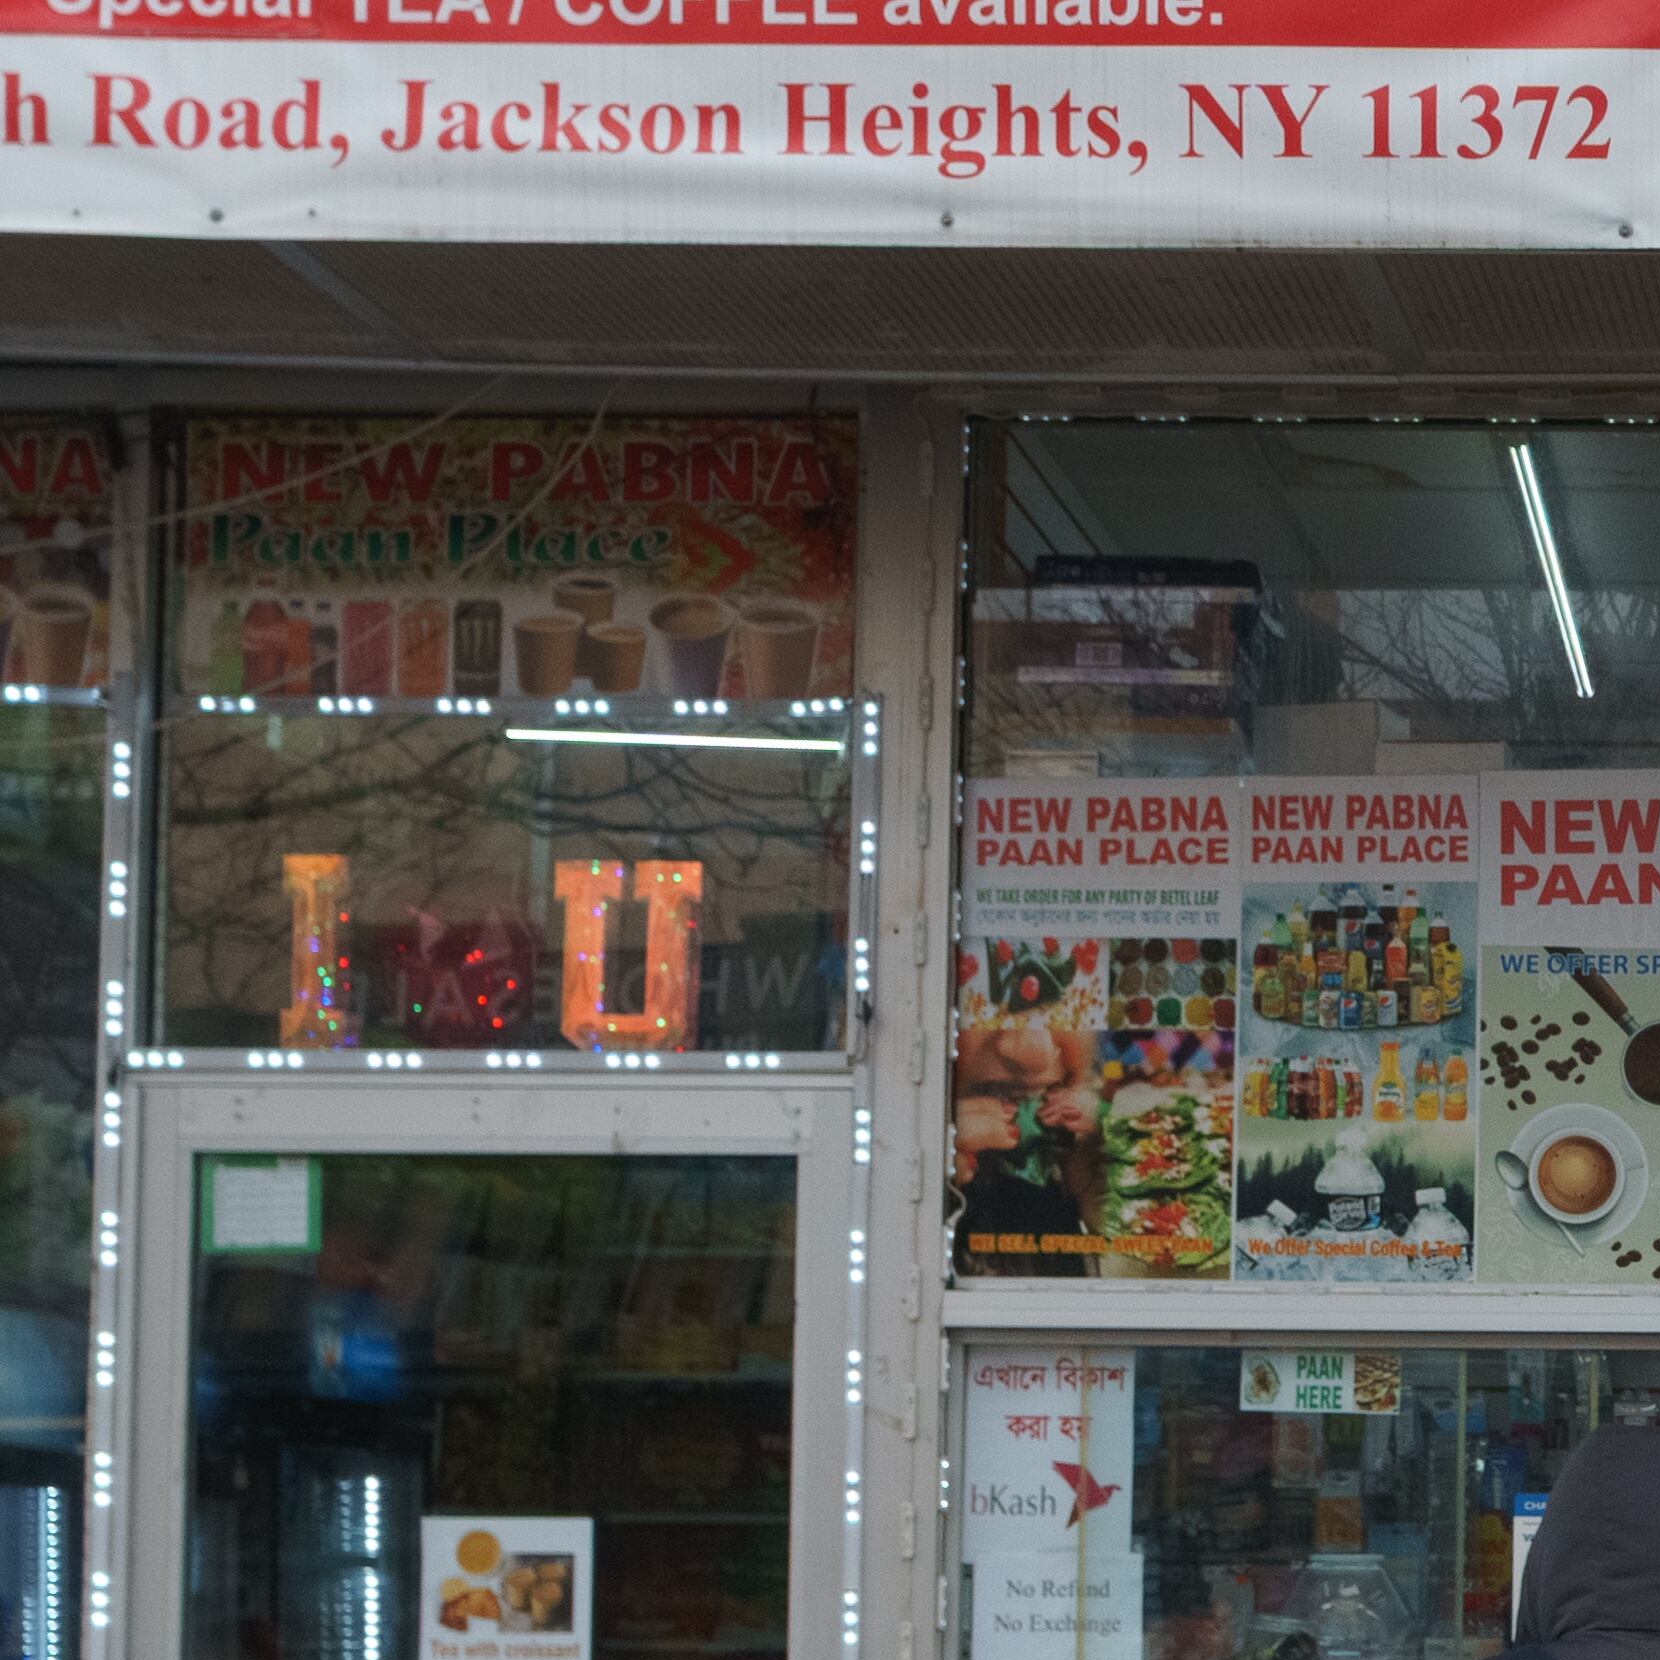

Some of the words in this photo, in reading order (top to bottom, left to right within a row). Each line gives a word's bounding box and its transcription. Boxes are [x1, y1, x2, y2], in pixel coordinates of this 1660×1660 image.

[85, 73, 349, 168] Road,
[379, 79, 744, 156] Jackson
[779, 82, 1149, 179] Heights,
[1178, 84, 1329, 160] NY
[1361, 83, 1612, 161] 11372
[976, 796, 1073, 834] NEW
[1086, 796, 1230, 834] PABNA
[976, 838, 1083, 866] PAAN
[1098, 838, 1230, 865] PLACE
[1500, 954, 1540, 975] WE
[1546, 954, 1627, 975] OFFER
[1295, 1355, 1344, 1380] PAAN
[1295, 1384, 1344, 1410] HERE
[1005, 1579, 1037, 1598] No
[994, 1614, 1023, 1634] No
